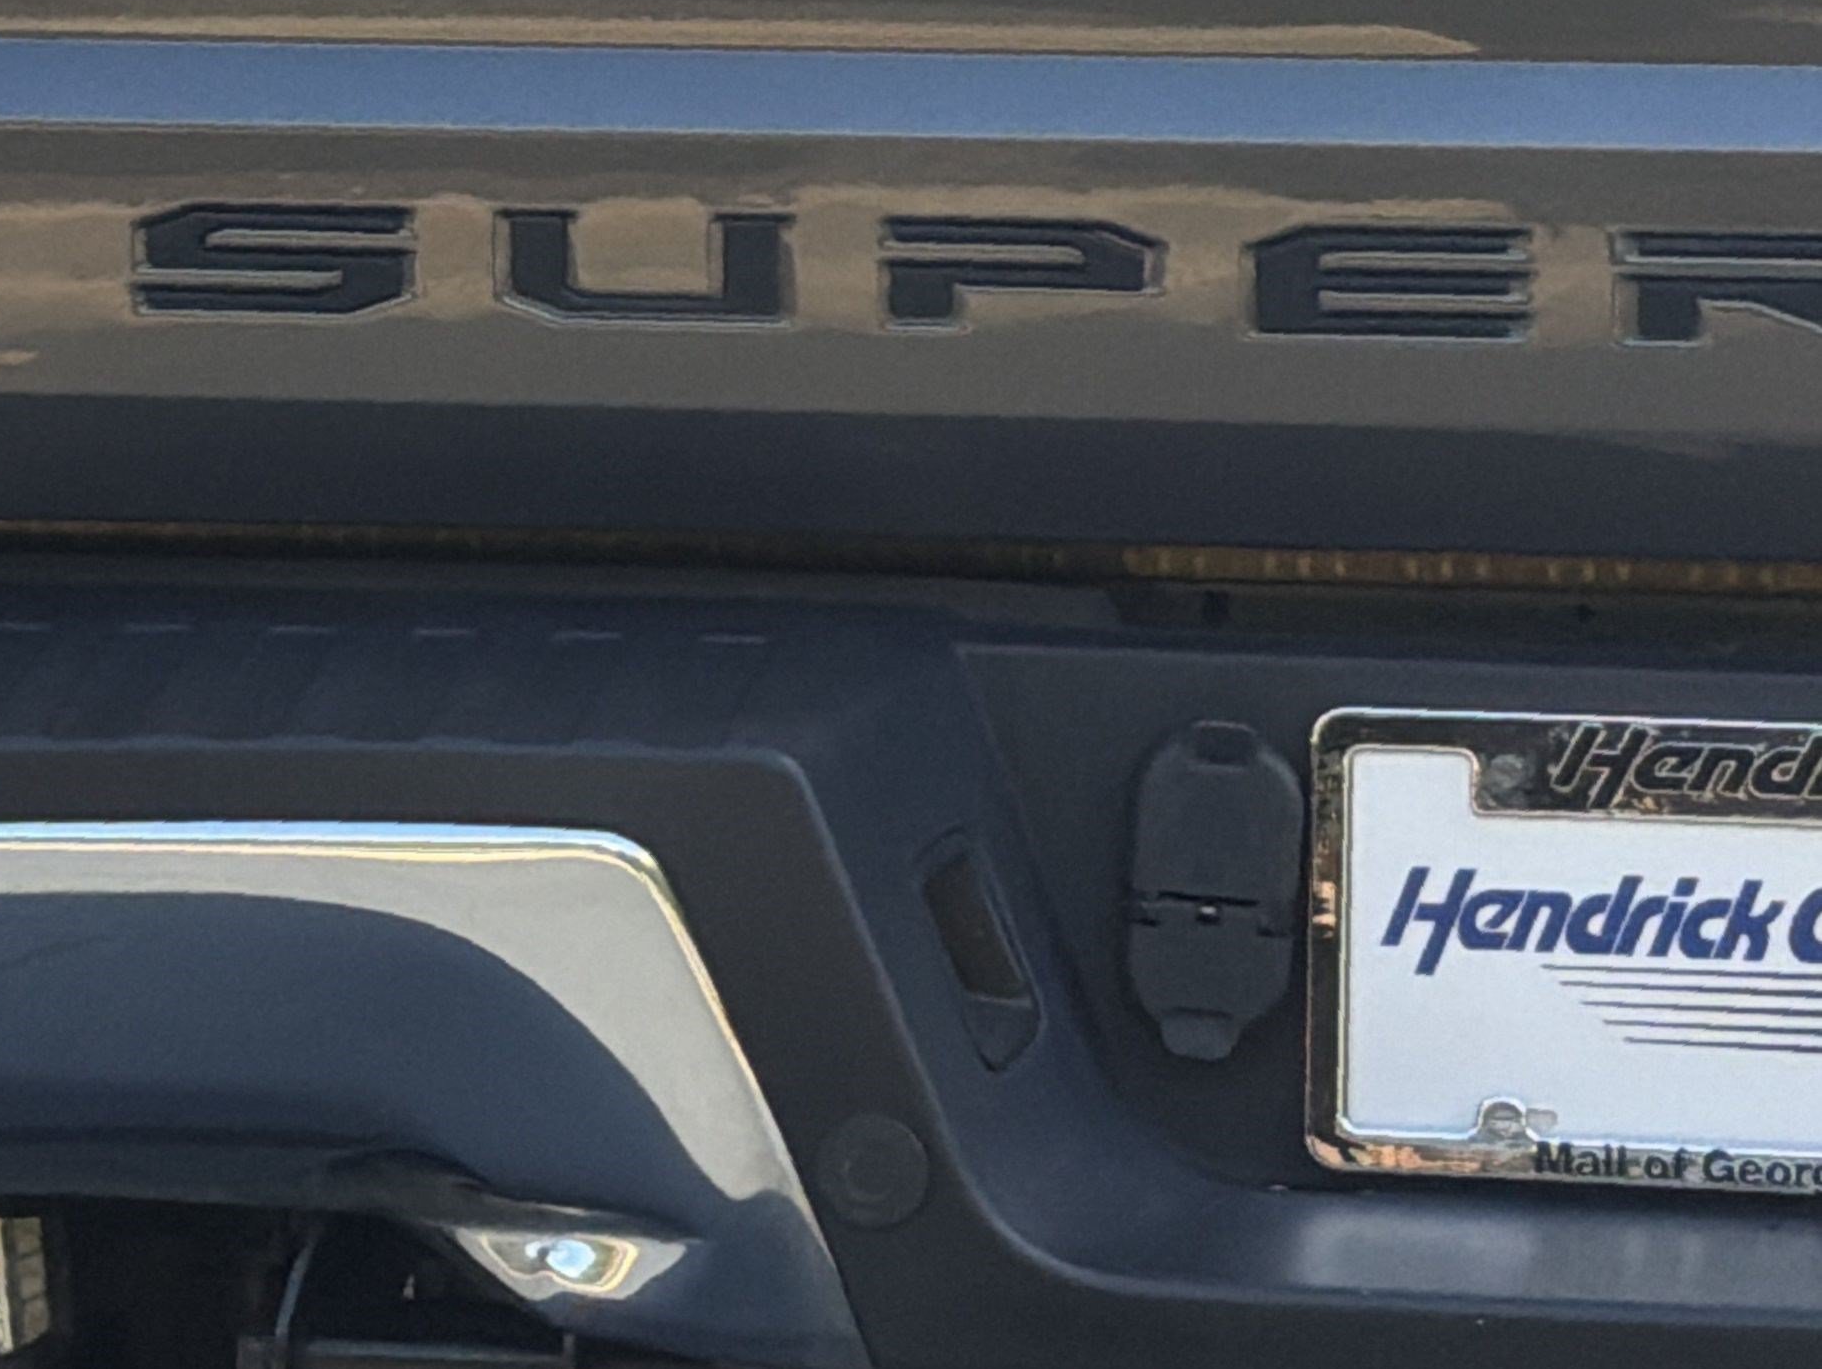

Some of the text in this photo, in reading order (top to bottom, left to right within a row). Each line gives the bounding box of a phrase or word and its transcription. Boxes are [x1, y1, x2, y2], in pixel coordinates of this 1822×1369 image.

[131, 201, 1822, 347] SUPER
[1380, 866, 1785, 976] Hendrick
[1533, 1141, 1627, 1177] Mall
[1643, 1146, 1689, 1180] of
